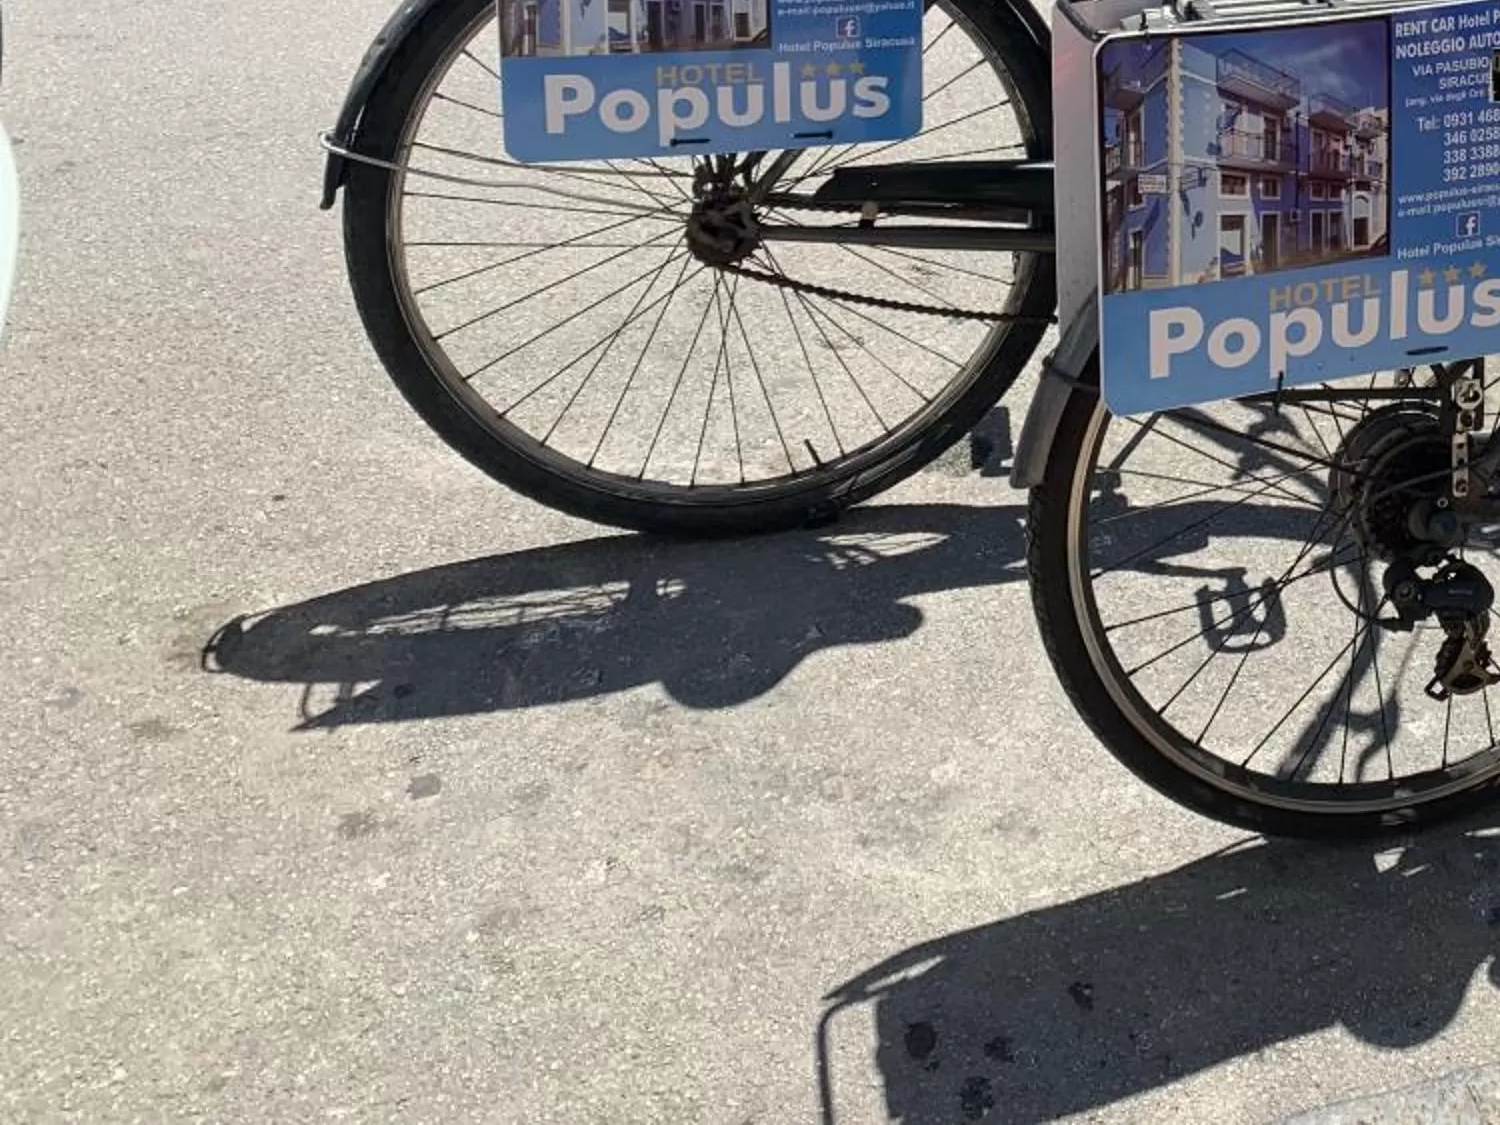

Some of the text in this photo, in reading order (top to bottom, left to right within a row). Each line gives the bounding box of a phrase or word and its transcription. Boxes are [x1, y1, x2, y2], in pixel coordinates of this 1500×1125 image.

[1395, 20, 1427, 38] RENT
[1431, 16, 1455, 33] CAR
[1458, 12, 1490, 30] Hotel
[779, 41, 810, 54] Hotel
[1395, 38, 1465, 60] NOLEGGIO
[656, 62, 765, 87] HOTEL
[1412, 63, 1433, 77] VIA
[543, 61, 891, 149] Populus
[1443, 110, 1473, 128] 0931
[1443, 130, 1467, 146] 346
[1443, 149, 1467, 164] 338
[1443, 166, 1467, 182] 392
[1397, 245, 1430, 260] Hotel
[1433, 239, 1483, 256] Populus
[1269, 275, 1382, 312] HOTEL
